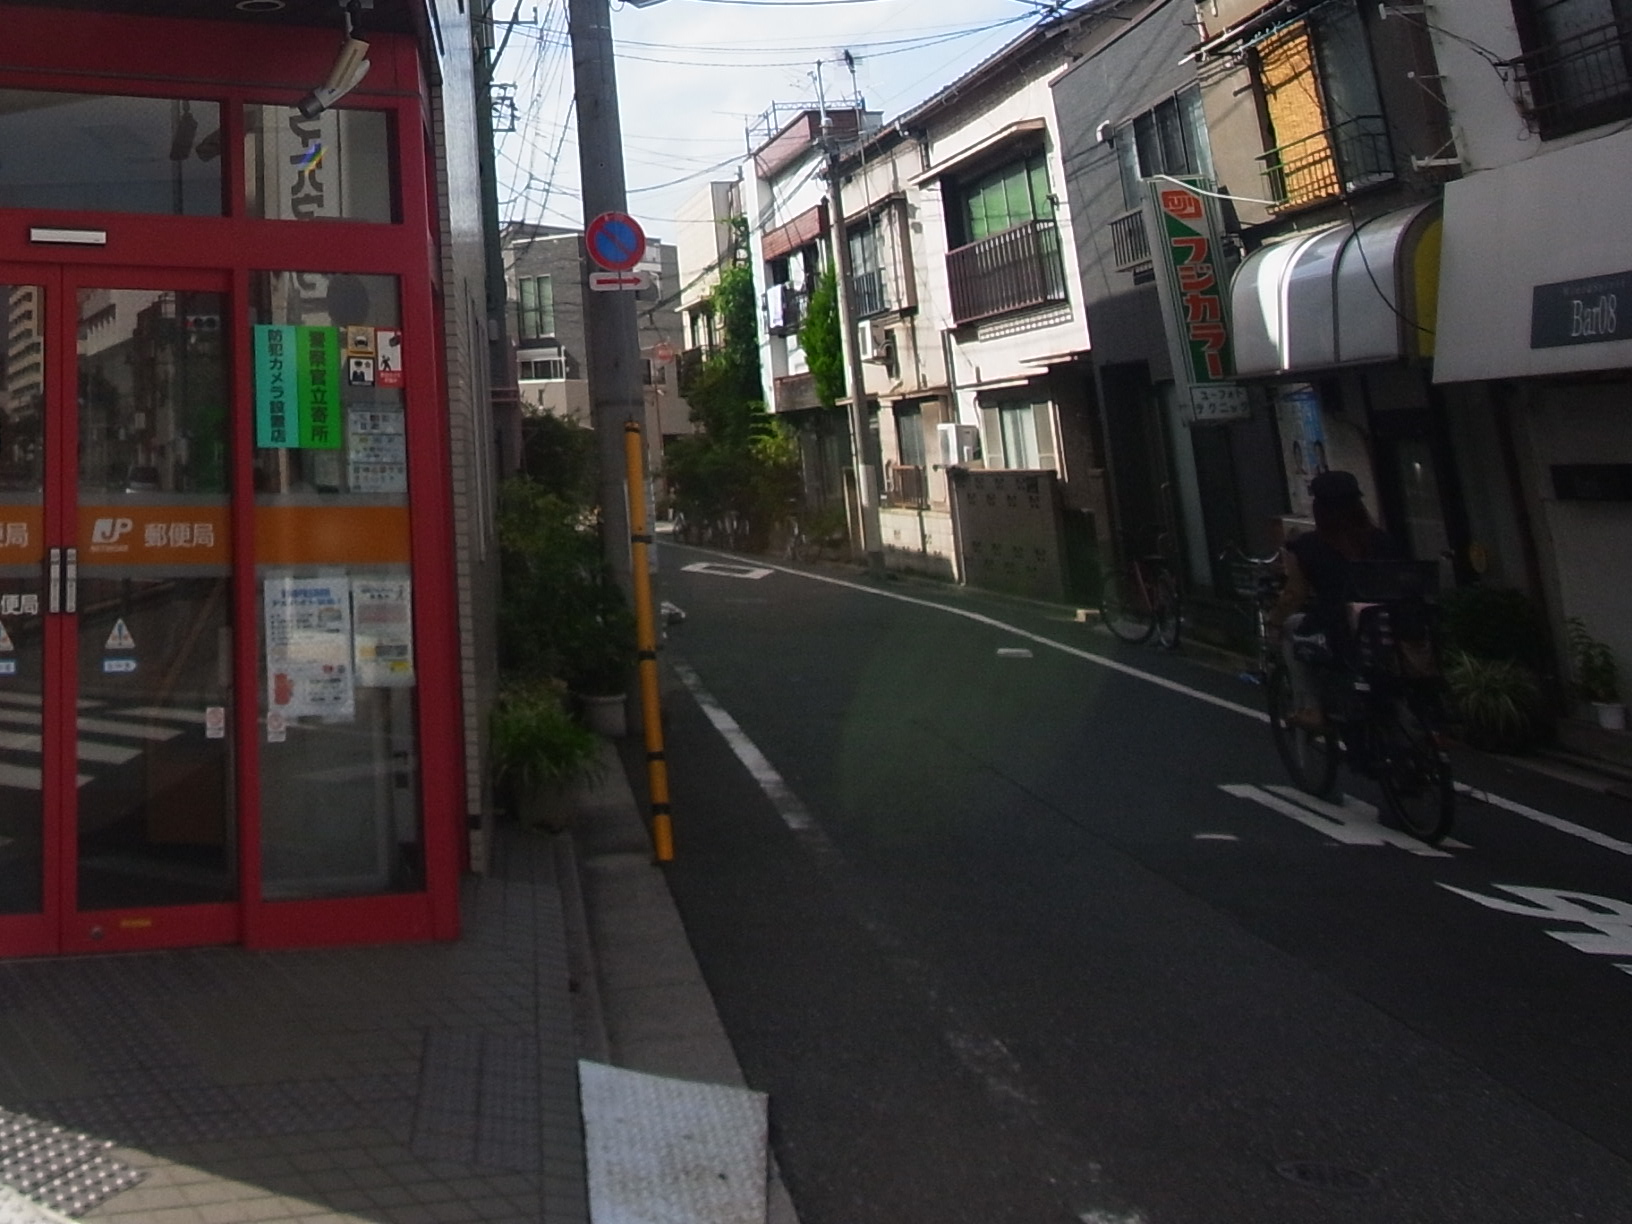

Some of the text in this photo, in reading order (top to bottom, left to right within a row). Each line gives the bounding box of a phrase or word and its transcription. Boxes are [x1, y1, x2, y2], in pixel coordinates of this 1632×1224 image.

[1171, 236, 1226, 380] フジカラー
[268, 329, 287, 443] 防犯カメラ設置店
[308, 330, 329, 443] 警察官立寄所
[144, 522, 214, 548] 郵便局
